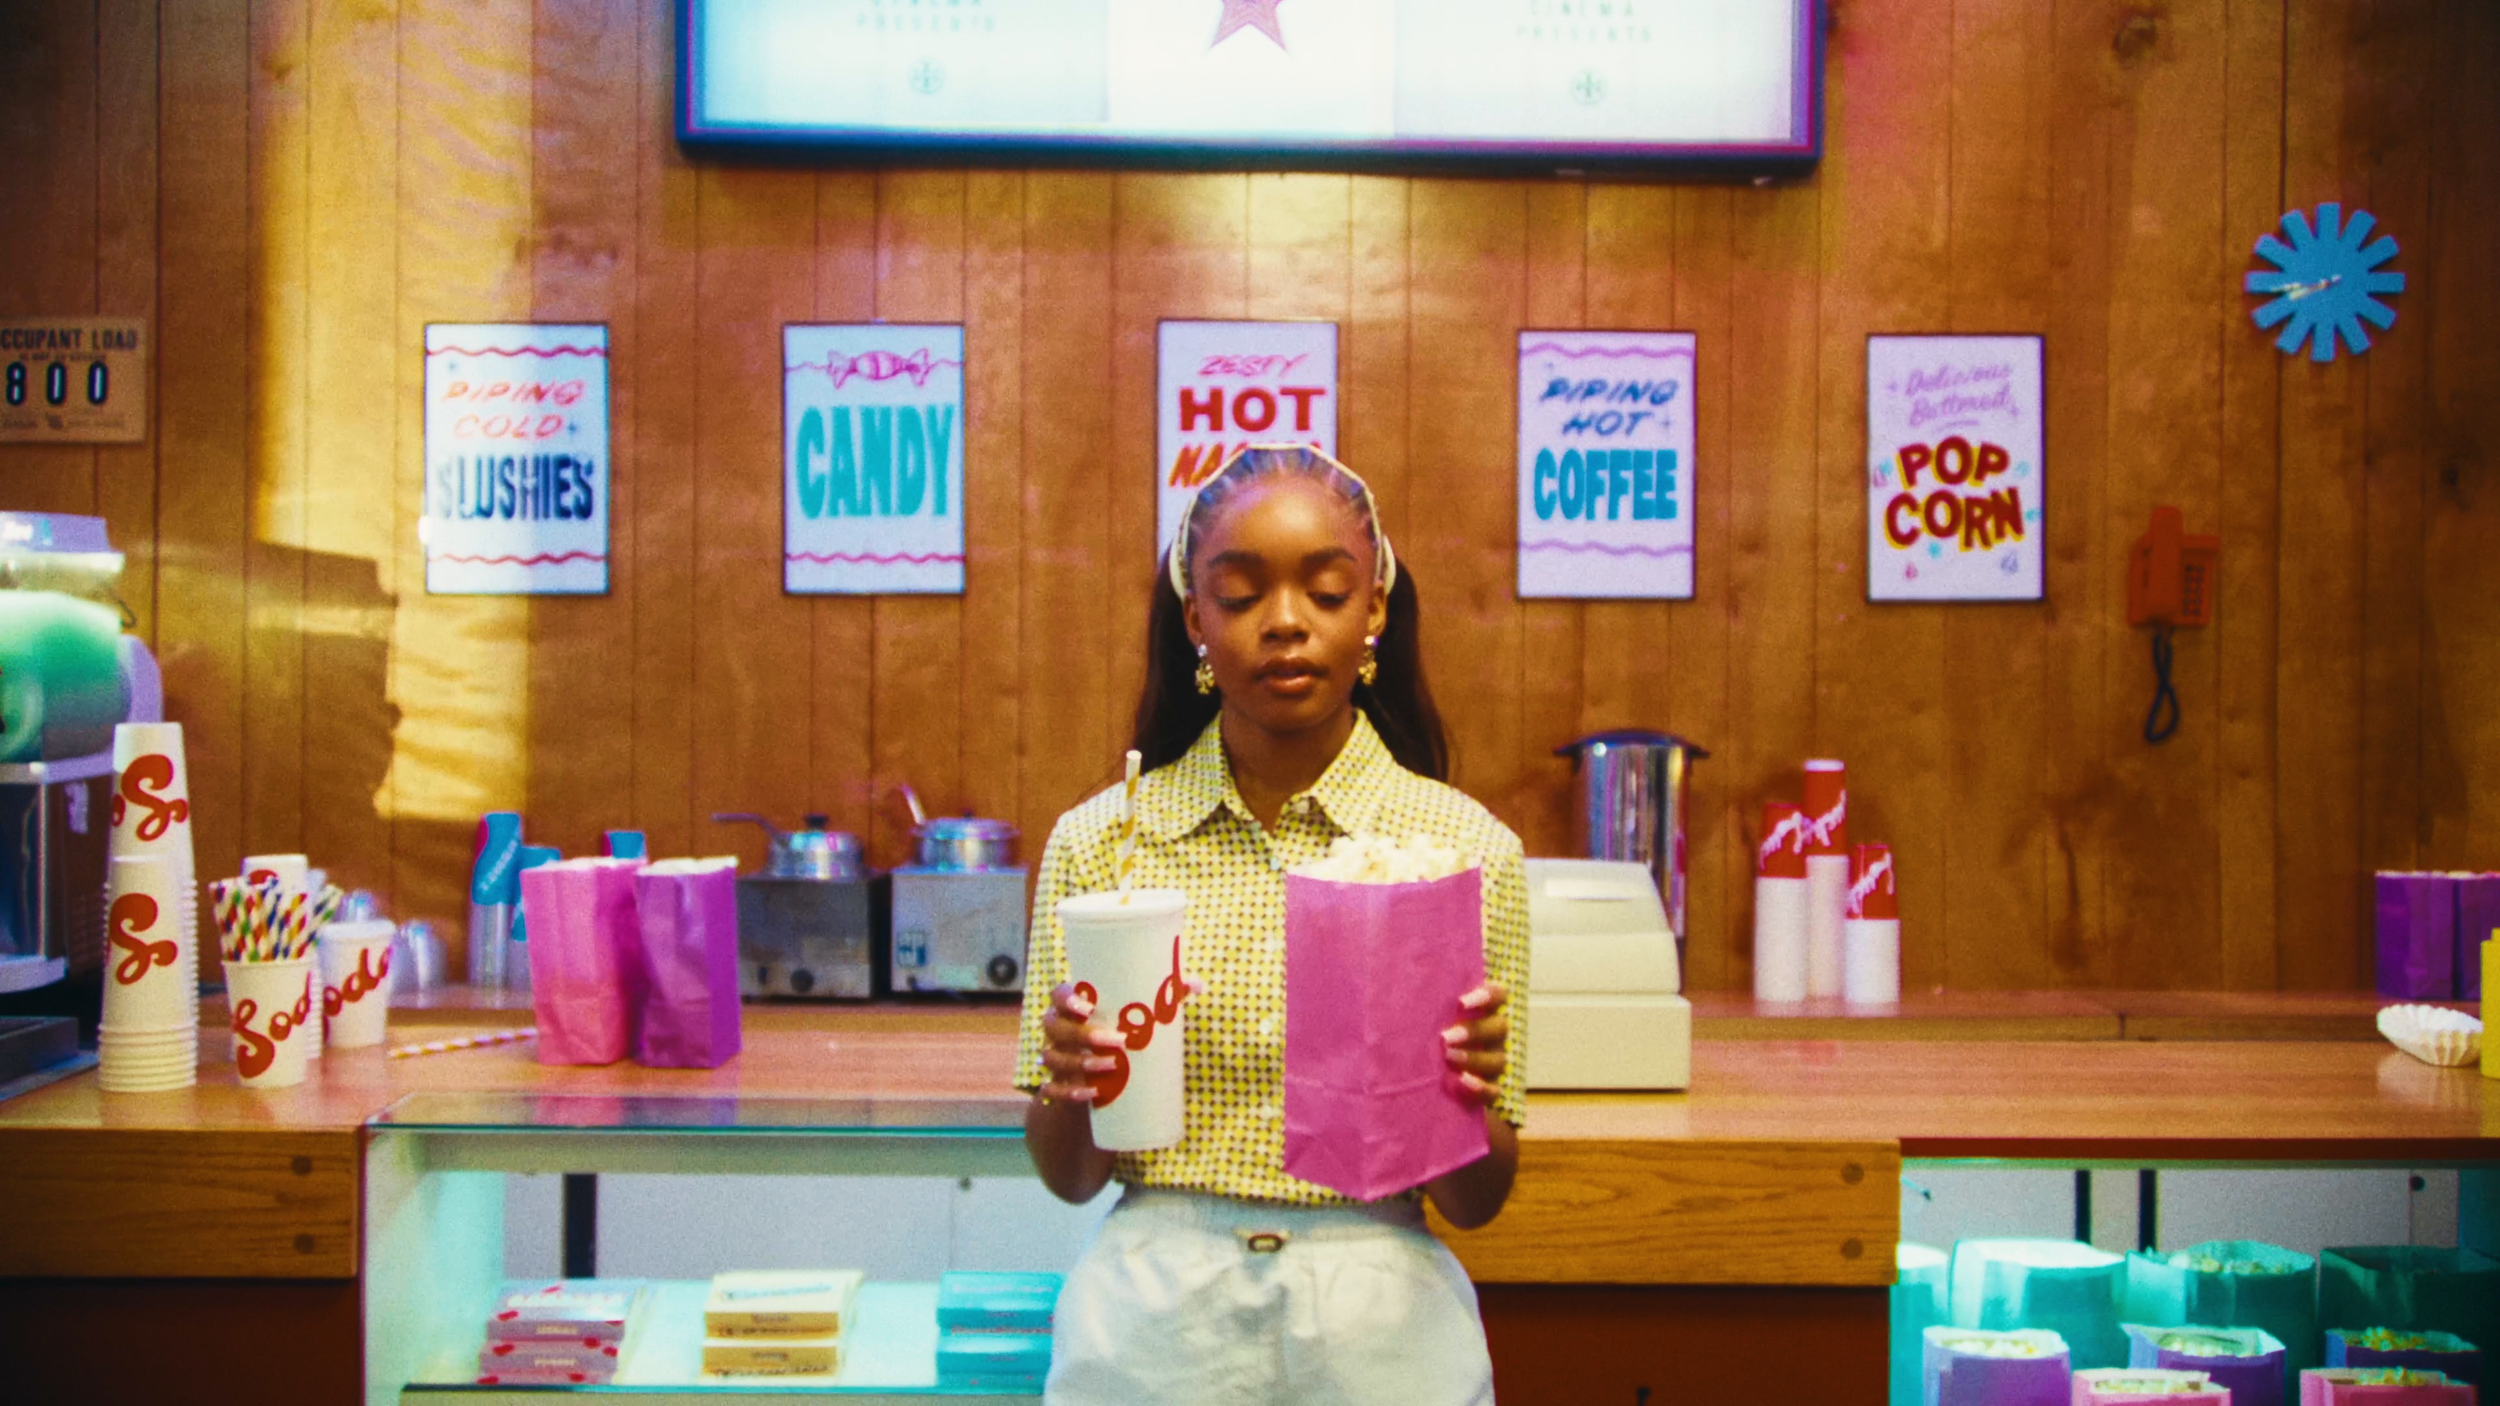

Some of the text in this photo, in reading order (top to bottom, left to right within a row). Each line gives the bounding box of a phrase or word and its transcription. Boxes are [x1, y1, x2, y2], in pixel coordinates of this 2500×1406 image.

[0, 329, 137, 350] CCUPANT LOAD
[1199, 354, 1309, 379] ZESTY
[1905, 363, 2010, 397] Delicious
[443, 380, 585, 405] PIPING
[1540, 377, 1678, 406] PIPING
[454, 414, 563, 439] COLD
[1179, 386, 1327, 433] HOT
[1561, 410, 1652, 437] HOT
[796, 404, 954, 519] CANDY
[1896, 435, 2010, 491] POP
[436, 454, 594, 519] SLUSHIES
[1533, 448, 1678, 521] COFFEE
[1884, 486, 2024, 551] CORN
